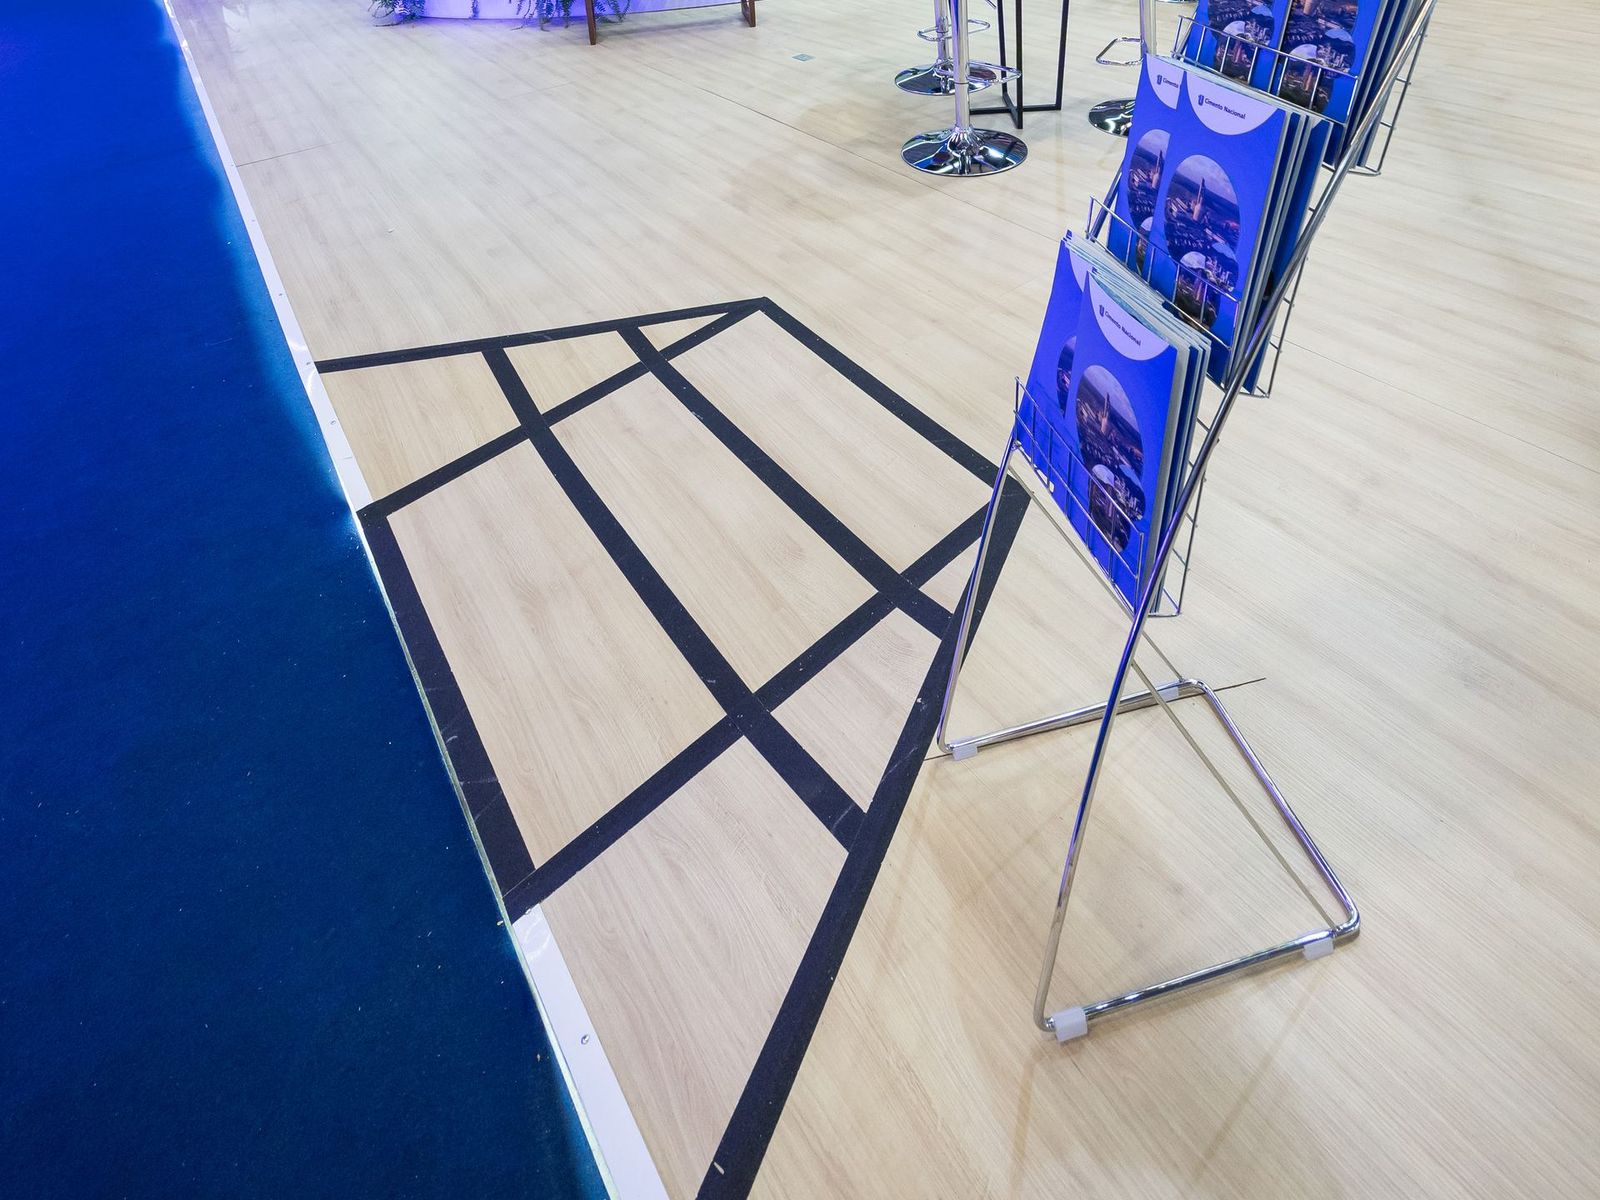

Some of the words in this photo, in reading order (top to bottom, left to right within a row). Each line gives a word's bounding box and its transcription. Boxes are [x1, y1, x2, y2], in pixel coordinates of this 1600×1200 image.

[1162, 77, 1179, 89] Cimento
[1204, 97, 1223, 111] Cimento
[1223, 105, 1247, 120] Nacional
[1104, 310, 1121, 330] Cimento
[1121, 325, 1142, 347] Nacional
